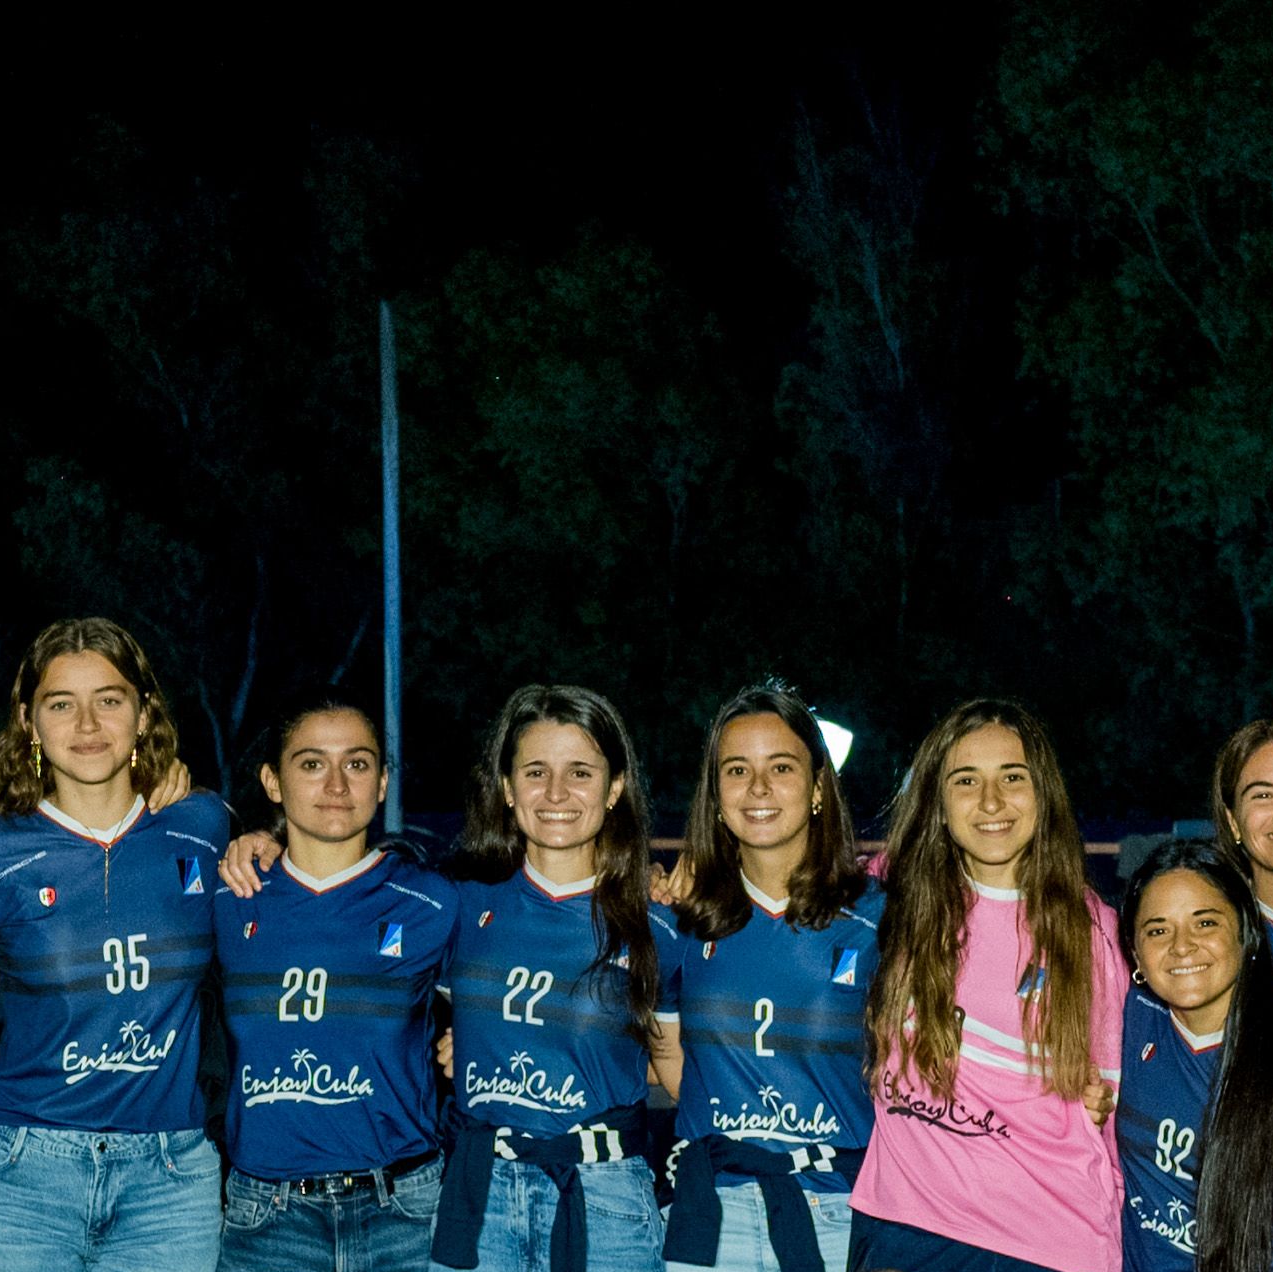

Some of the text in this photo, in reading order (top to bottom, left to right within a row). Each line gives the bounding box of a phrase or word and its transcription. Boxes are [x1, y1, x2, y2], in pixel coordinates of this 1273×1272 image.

[103, 933, 150, 995] 35
[278, 966, 328, 1022] 29
[502, 966, 555, 1026] 22
[754, 997, 775, 1057] 2
[242, 1063, 375, 1099] Enjoy Cuba
[465, 1060, 587, 1110] Enjoy Cuba
[780, 1102, 840, 1135] Cuba
[1156, 1117, 1195, 1181] 92
